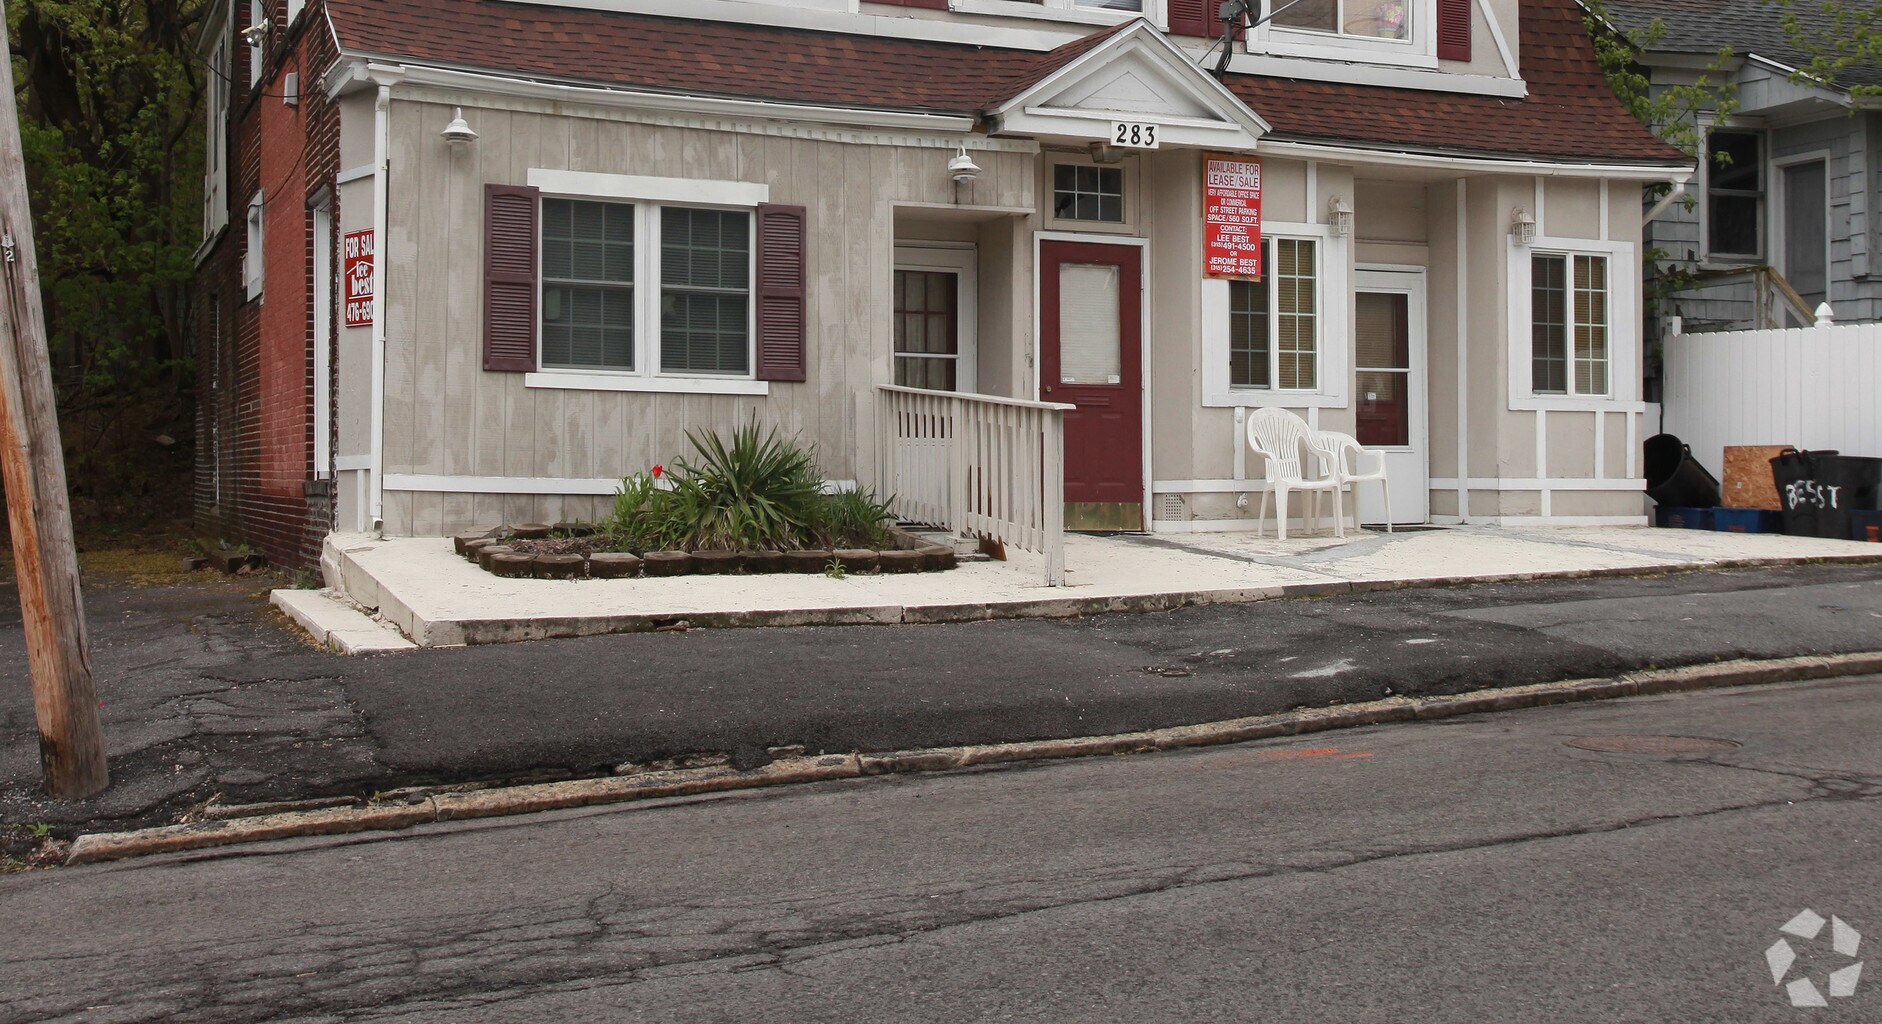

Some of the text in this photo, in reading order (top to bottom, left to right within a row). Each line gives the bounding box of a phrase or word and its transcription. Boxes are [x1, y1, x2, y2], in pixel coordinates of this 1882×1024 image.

[1116, 123, 1155, 146] 283
[1208, 162, 1258, 176] AVAILABLE FOR
[1208, 174, 1258, 188] LEASE/SALE
[1218, 190, 1238, 198] AFFORDABLE
[1238, 190, 1248, 198] OFFICE
[1250, 192, 1260, 200] SPACE
[1220, 206, 1238, 214] STREET
[1238, 208, 1258, 216] PARKING
[345, 236, 359, 259] FOR
[5, 250, 15, 262] 2
[1210, 258, 1258, 266] JEROME BEST
[356, 260, 368, 277] lee
[351, 270, 374, 296] best
